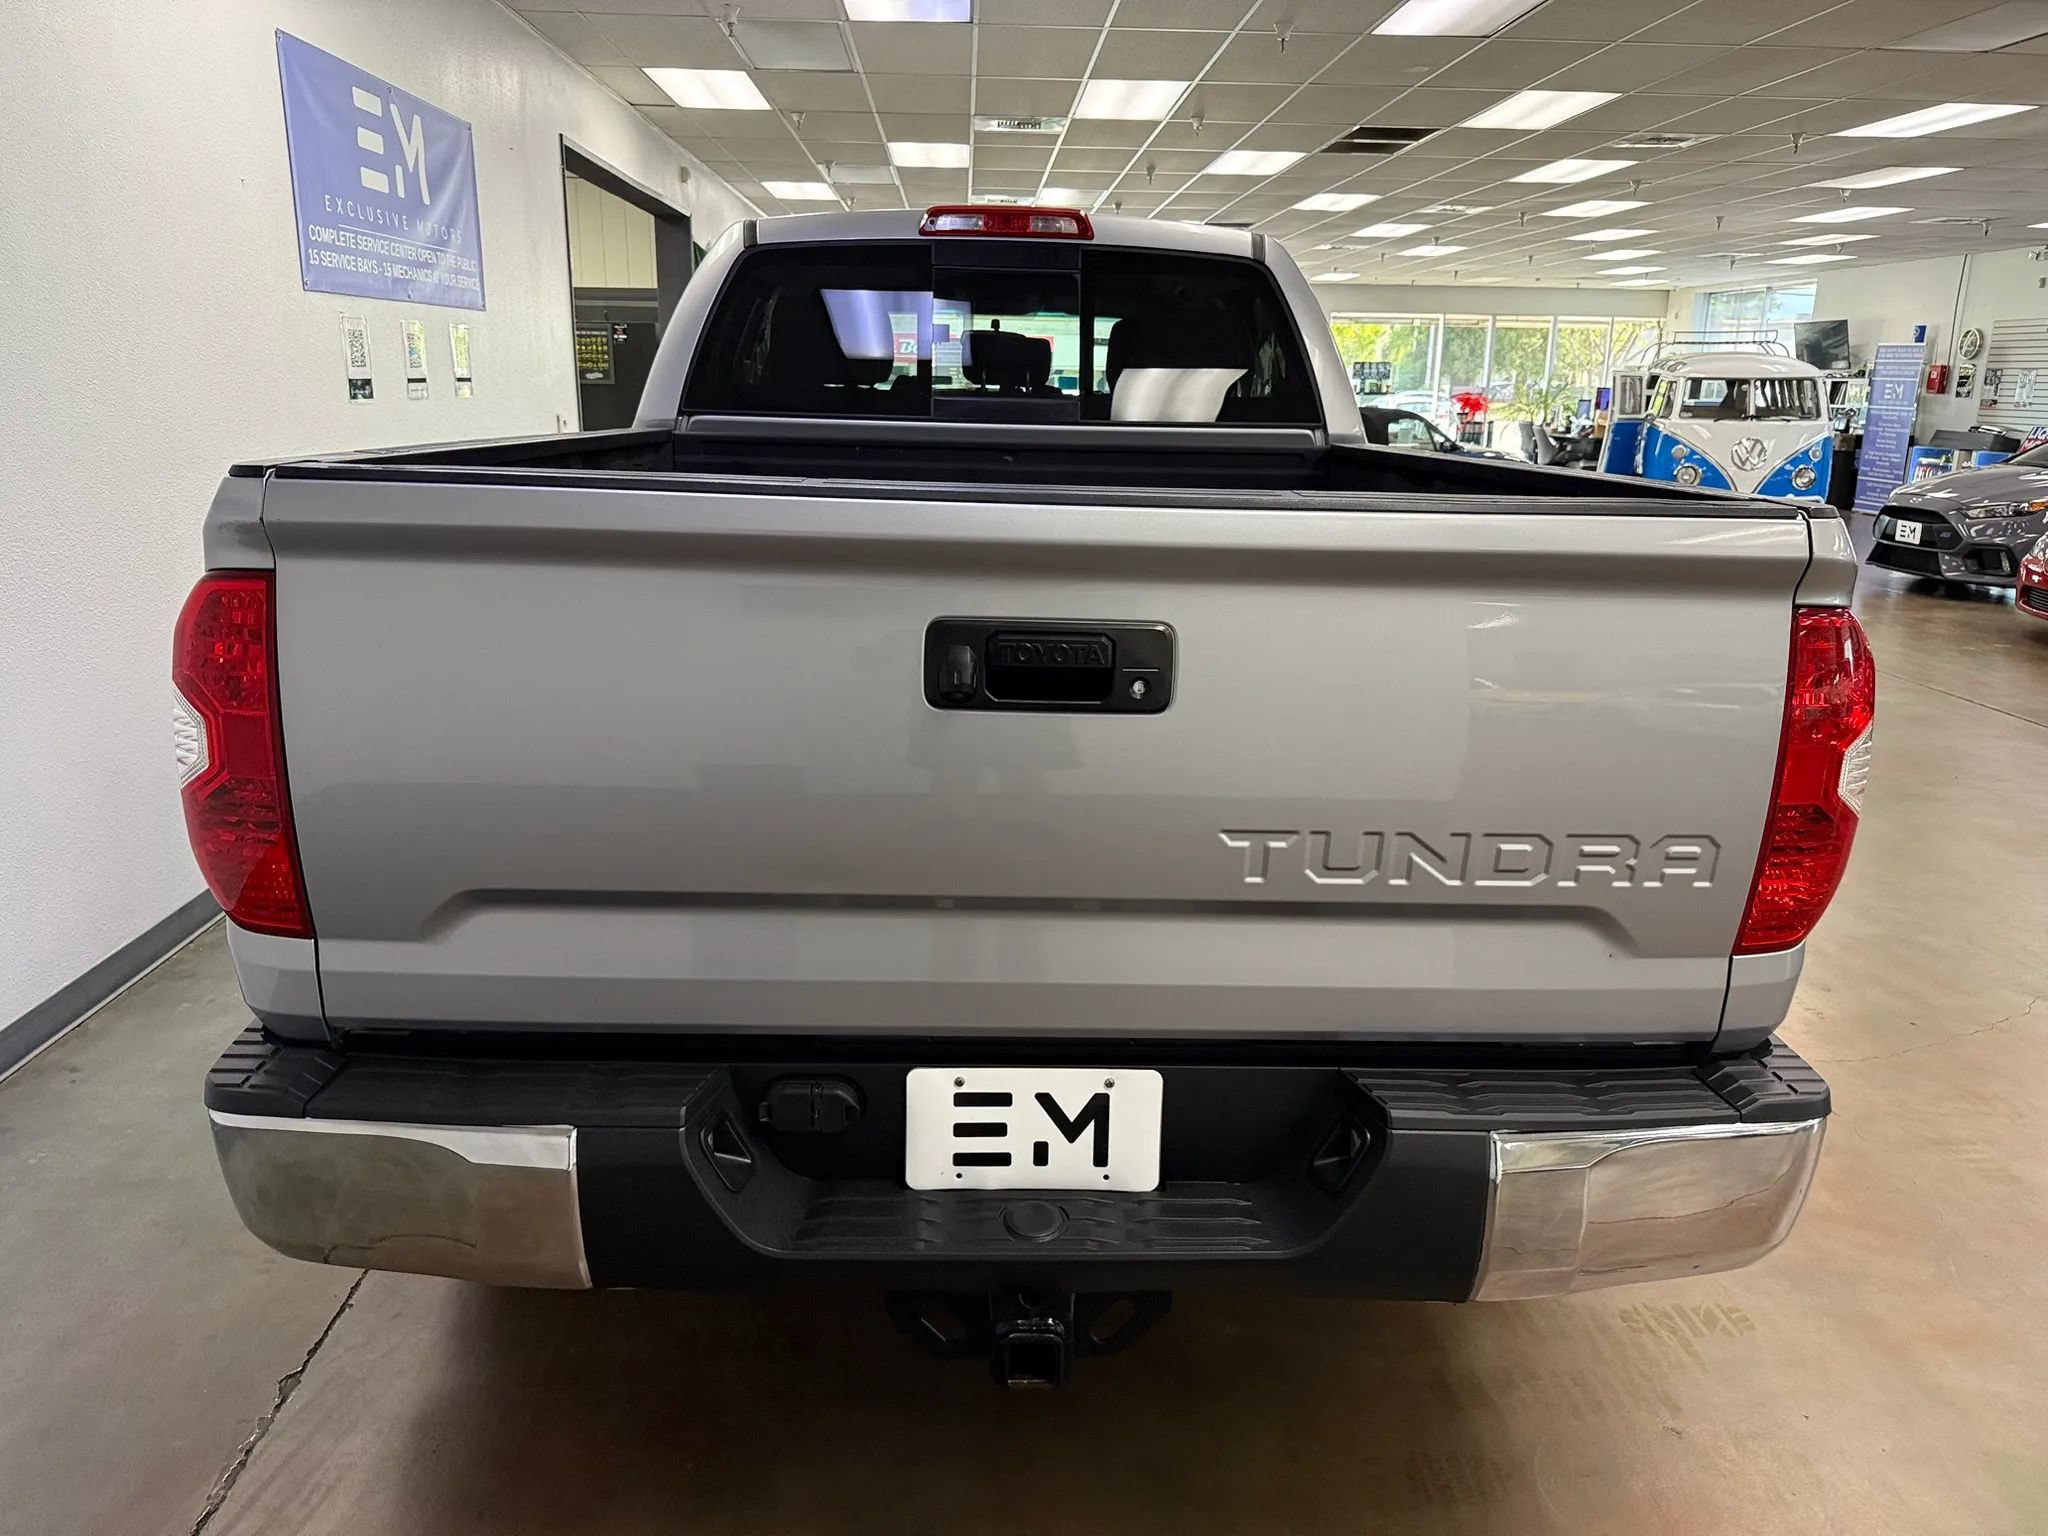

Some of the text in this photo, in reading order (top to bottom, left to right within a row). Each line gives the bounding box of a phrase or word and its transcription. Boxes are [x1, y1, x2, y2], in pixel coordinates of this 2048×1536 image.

[352, 86, 430, 205] EM
[325, 194, 462, 244] EXCLUSIVE MOTORS
[308, 224, 357, 249] COMPLETE
[356, 235, 390, 255] SERVICE
[390, 241, 417, 260] CENTER
[417, 247, 437, 264] OPEN
[308, 248, 320, 265] 15
[320, 250, 357, 271] SERVICE
[357, 256, 379, 275] BAYS
[383, 262, 392, 277] 15
[391, 263, 433, 282] MECHANICS
[1884, 383, 1904, 400] EM
[1900, 524, 1917, 540] EM
[1000, 642, 1105, 666] TOYOTA
[1218, 829, 1722, 887] TUNDRA
[952, 1092, 1111, 1168] EM
